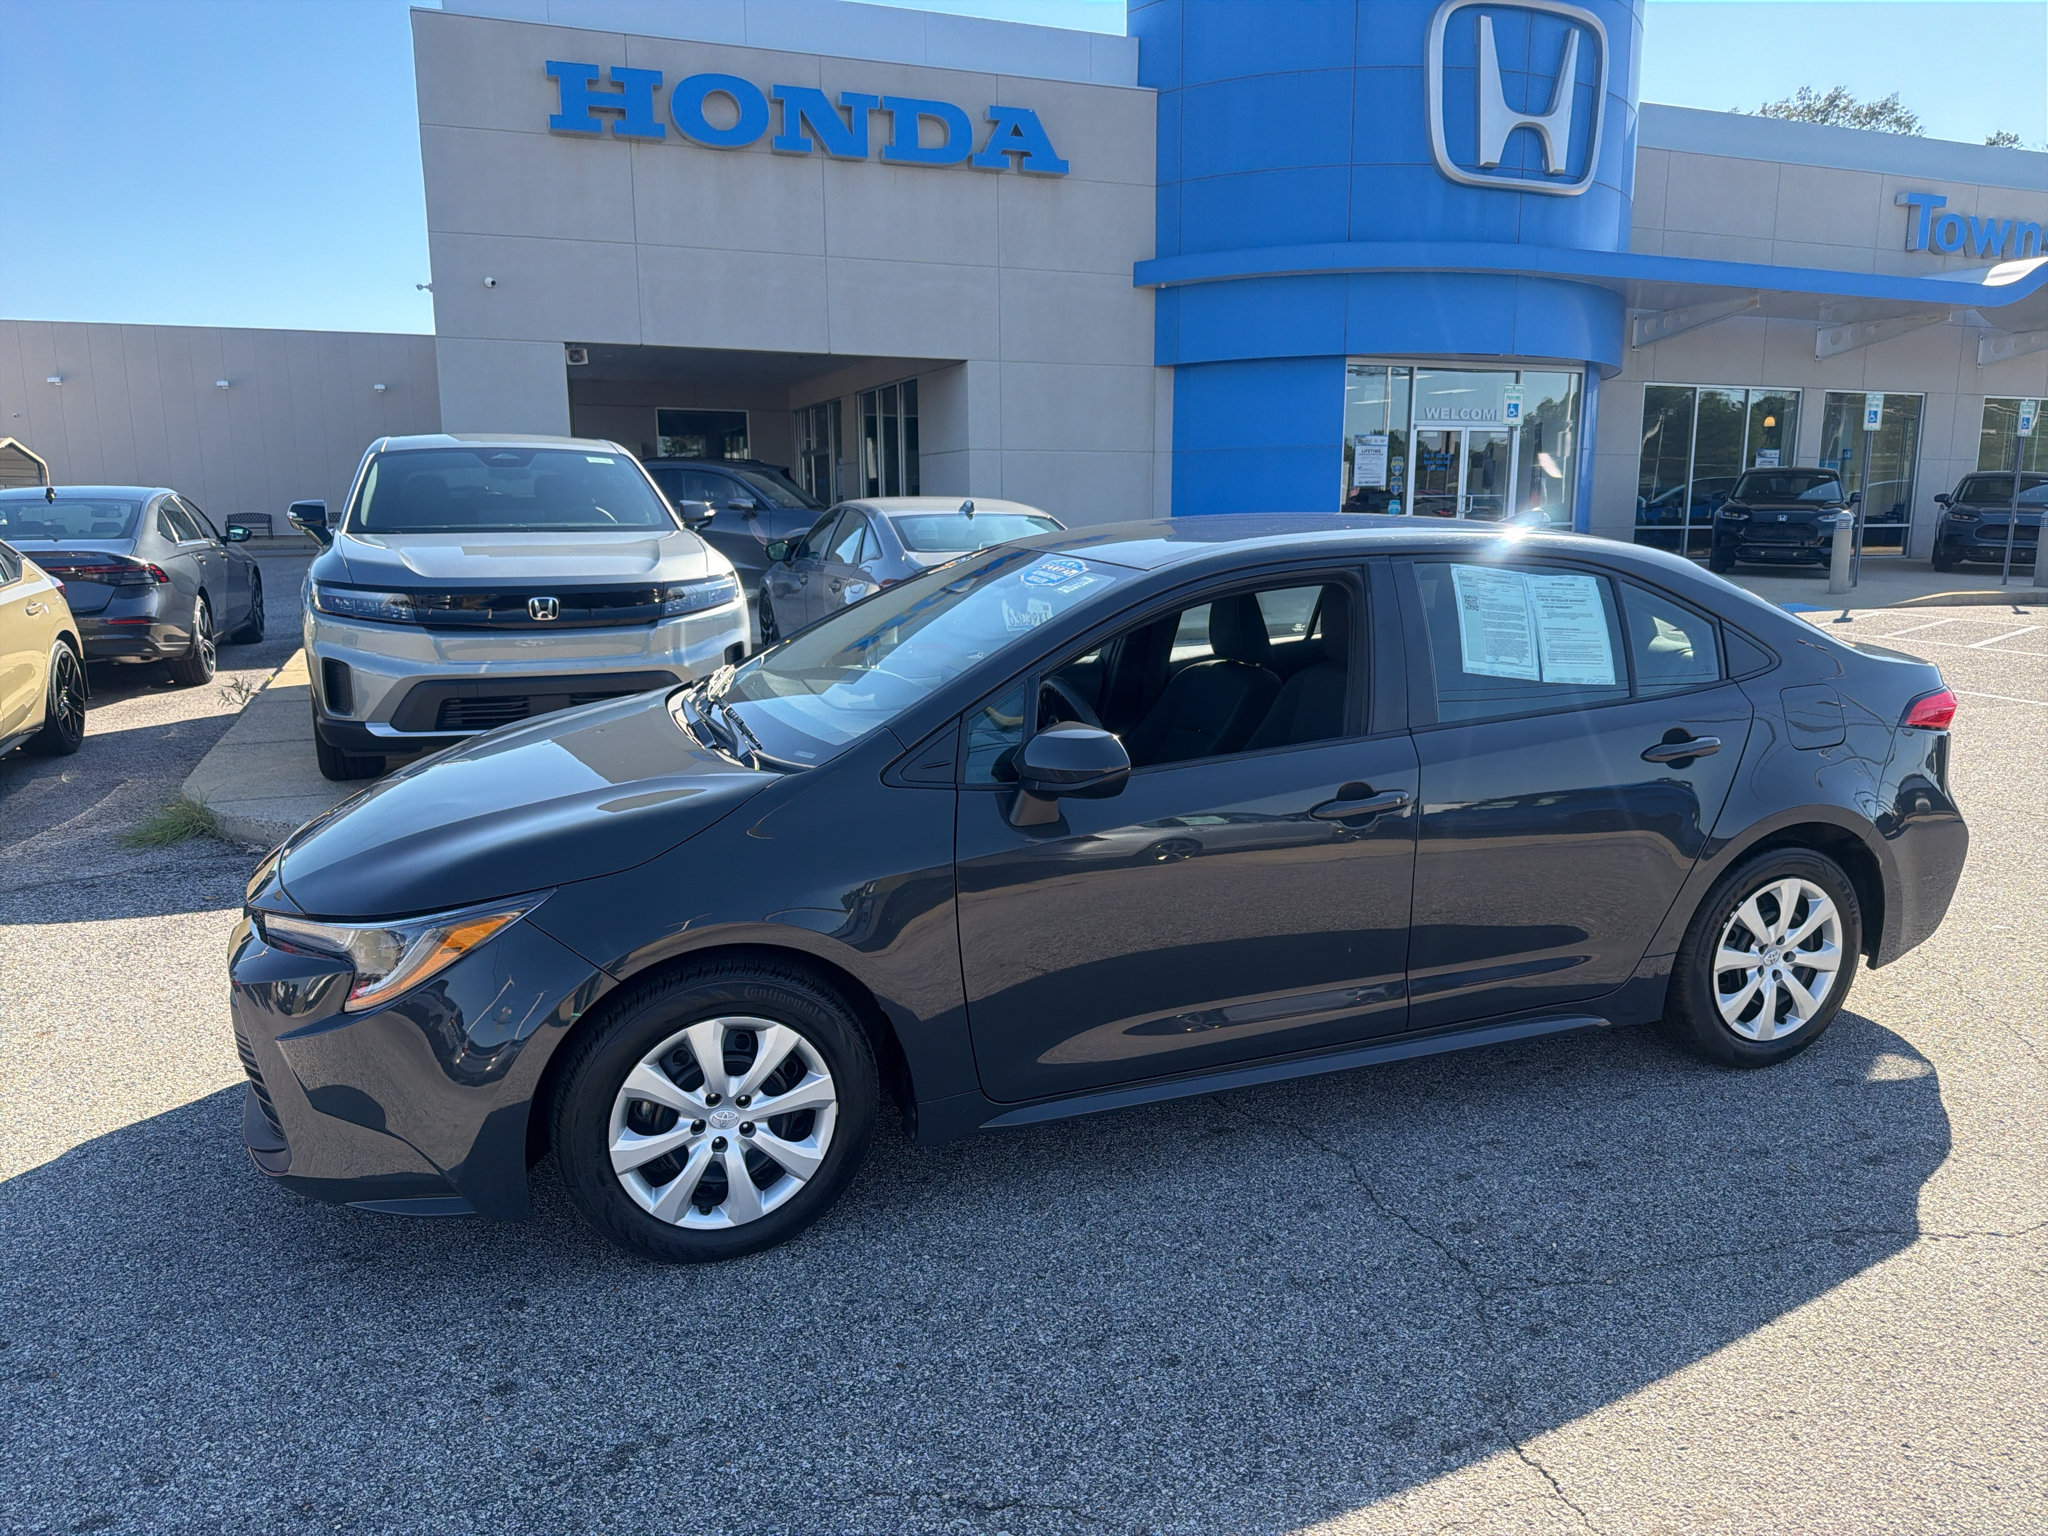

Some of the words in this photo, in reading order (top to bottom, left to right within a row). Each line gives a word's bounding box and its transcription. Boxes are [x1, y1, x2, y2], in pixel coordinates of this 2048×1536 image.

[545, 60, 1070, 177] HONDA
[1906, 191, 2048, 259] Town
[744, 985, 819, 1017] Continental
